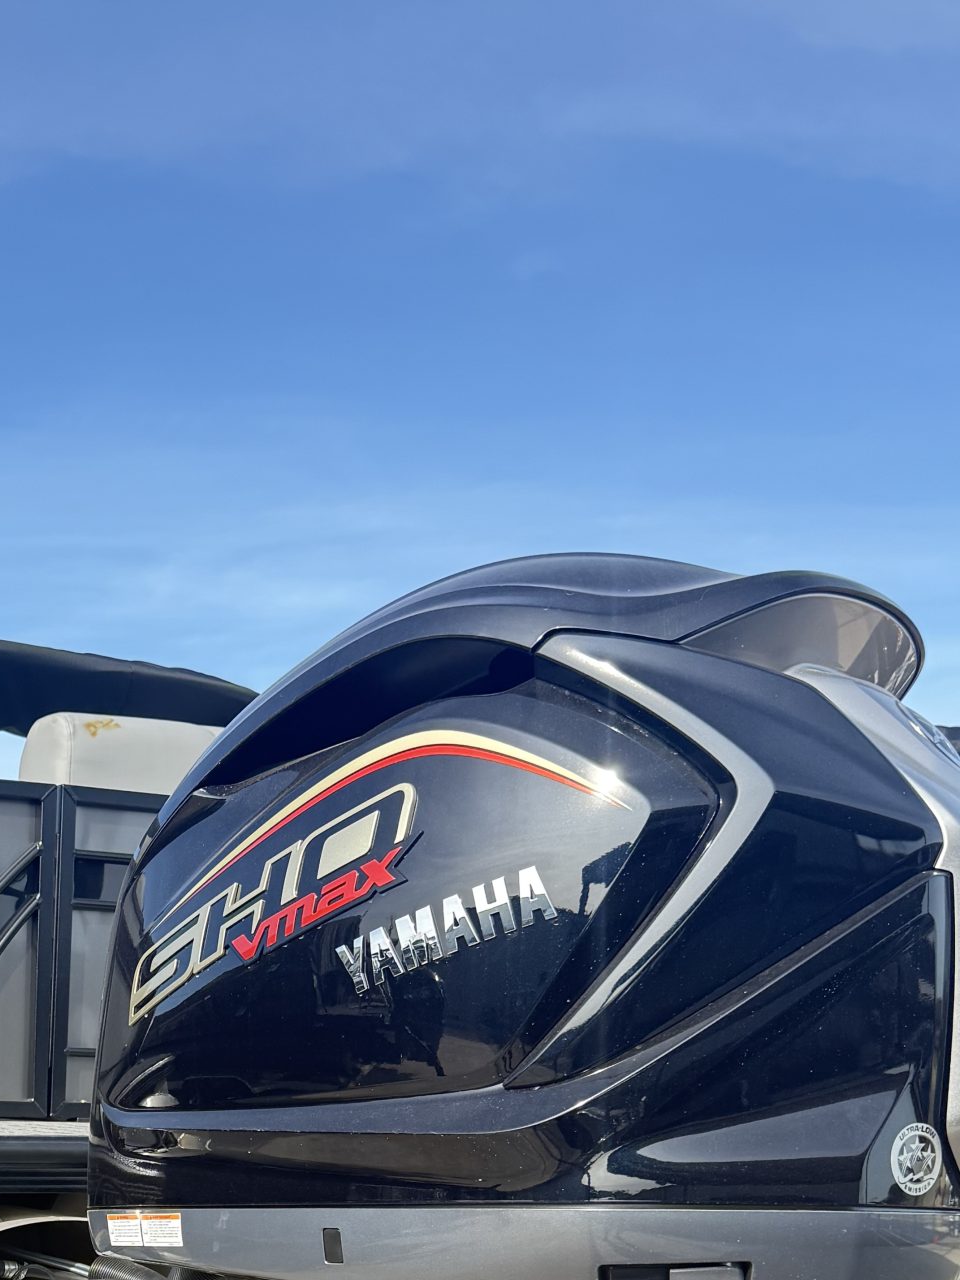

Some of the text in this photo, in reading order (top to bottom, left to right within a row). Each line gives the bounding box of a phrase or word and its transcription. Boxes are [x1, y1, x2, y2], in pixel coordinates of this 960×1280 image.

[128, 782, 418, 1027] SHO
[334, 865, 558, 995] YAMAHA
[899, 1125, 936, 1141] ULTRA-LOW
